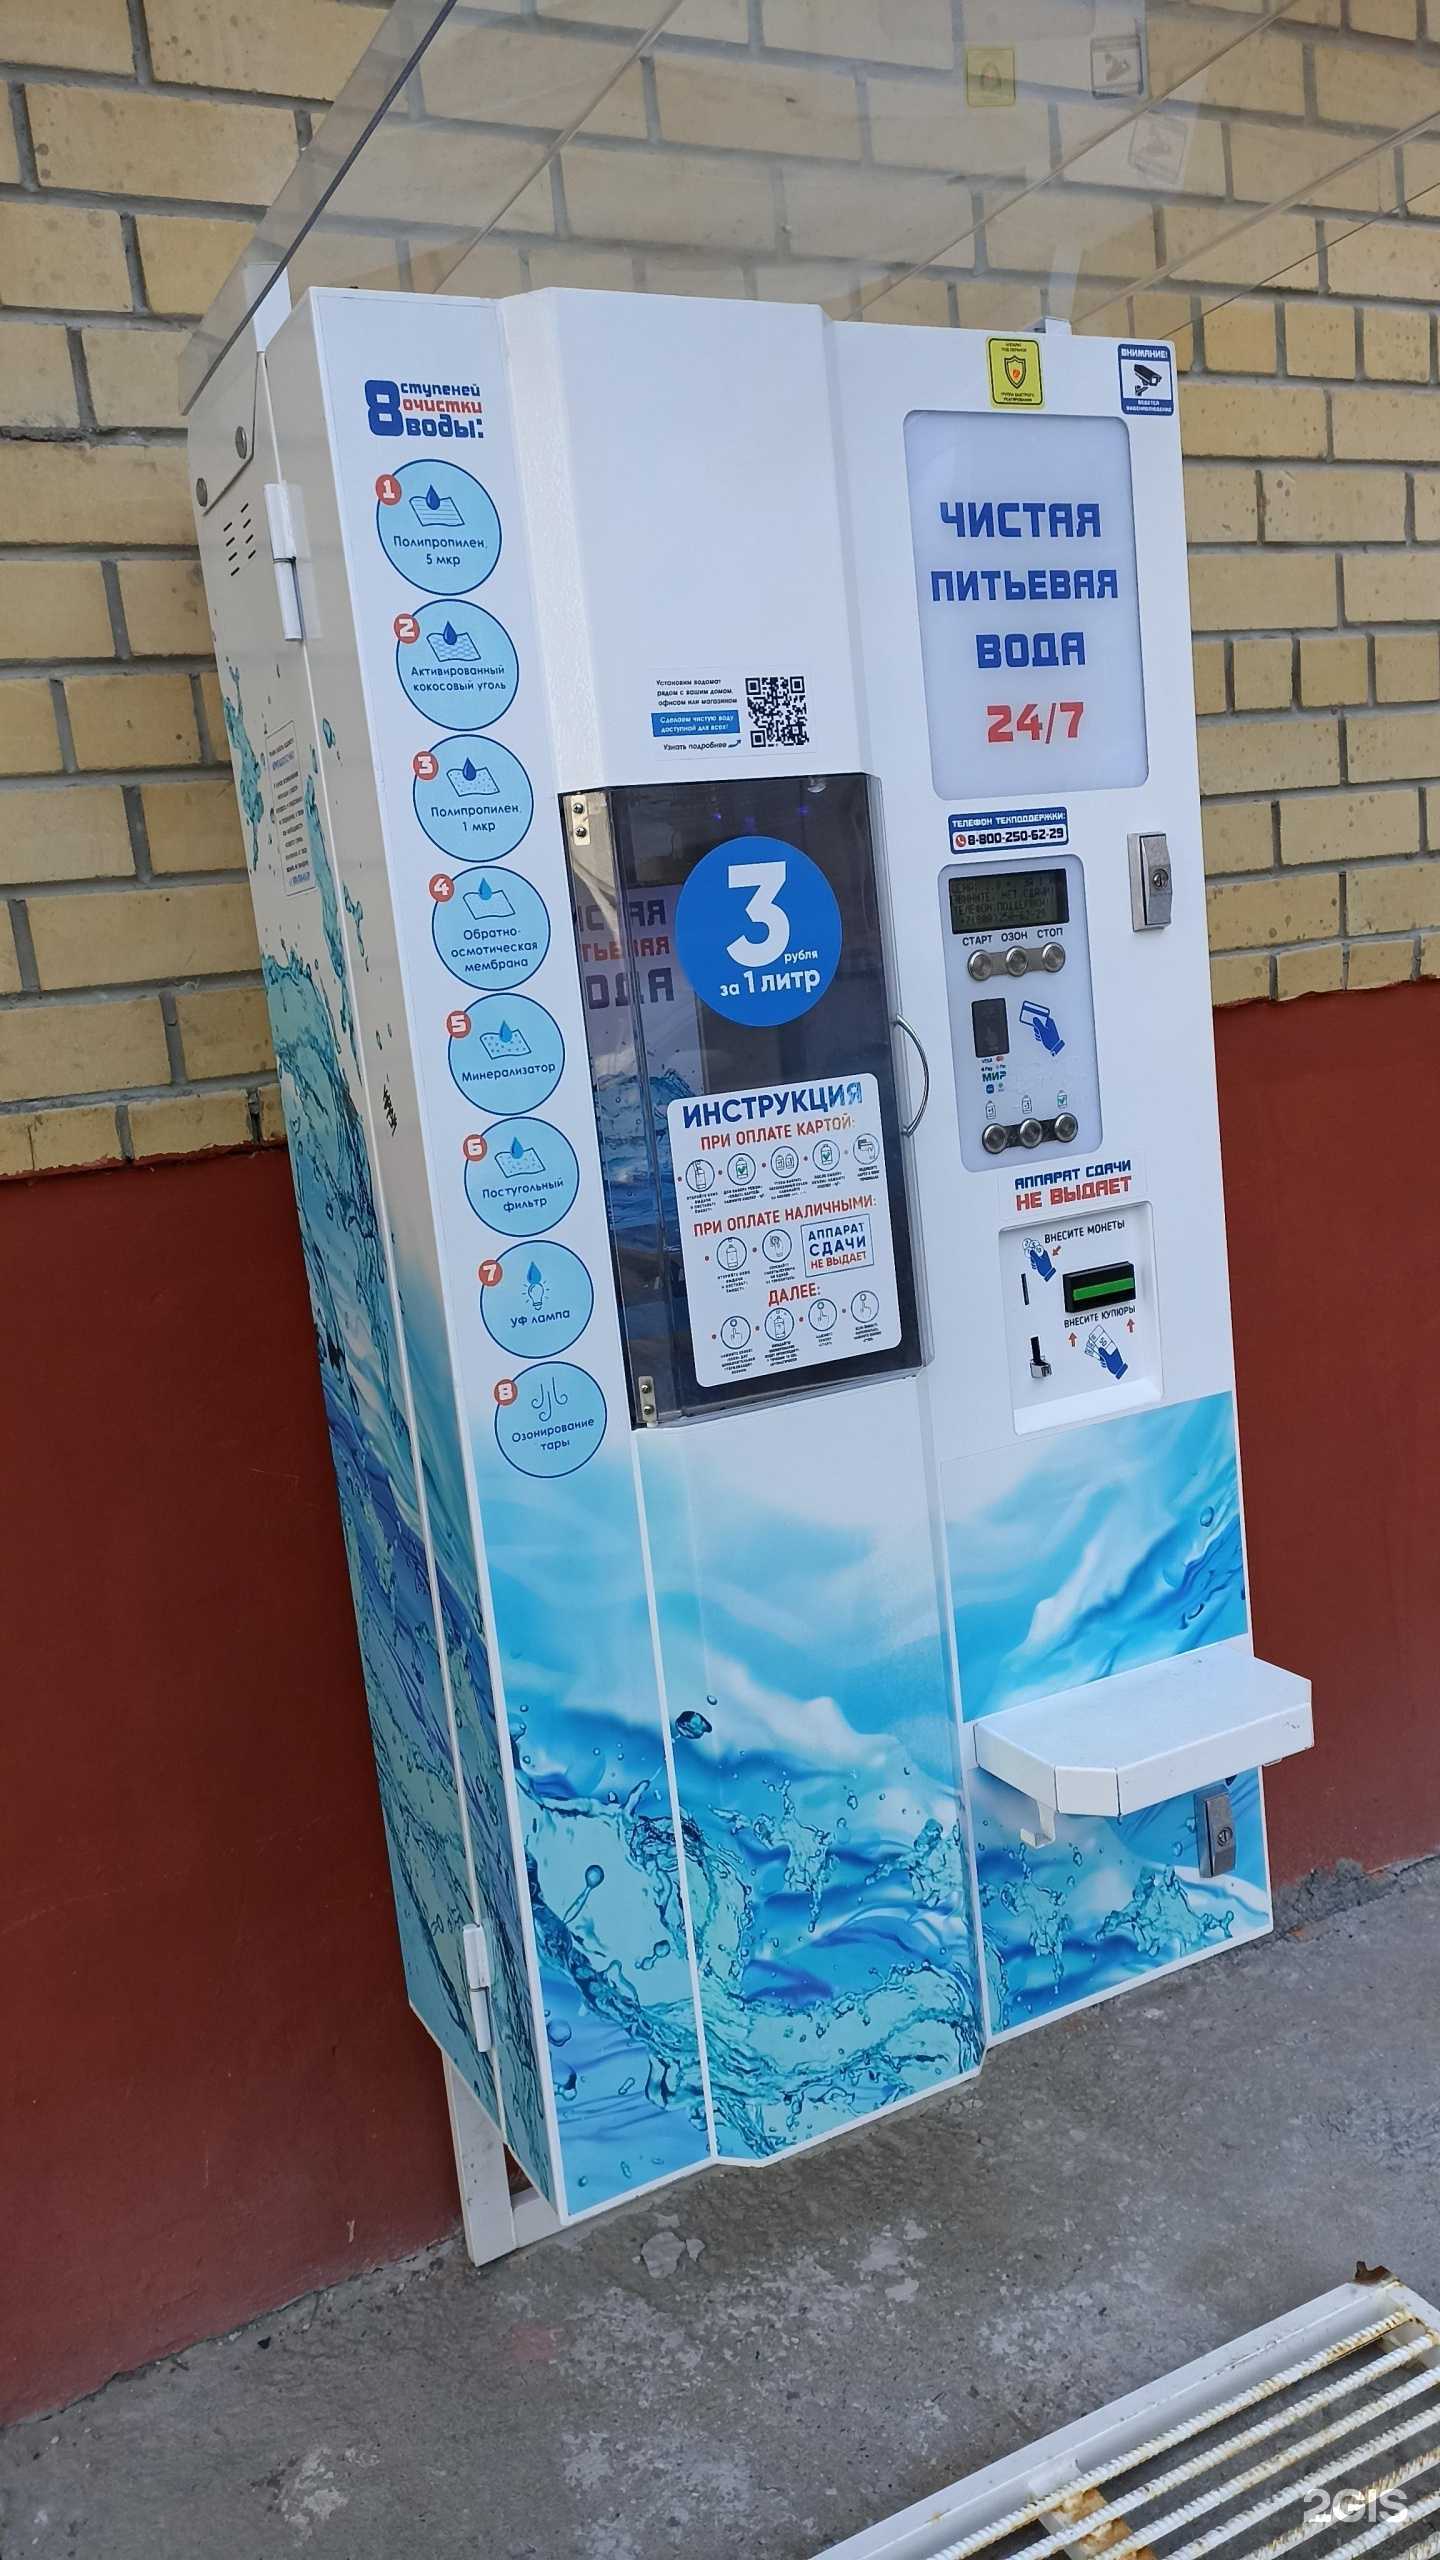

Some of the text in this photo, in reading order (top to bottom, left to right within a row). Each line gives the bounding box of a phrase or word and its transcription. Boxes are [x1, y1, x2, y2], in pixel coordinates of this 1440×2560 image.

[1121, 348, 1168, 359] ВНИМАНИЕ!
[401, 383, 481, 397] ступеней
[365, 380, 404, 436] 8
[403, 399, 482, 413] очистки
[406, 414, 484, 438] воды:
[382, 479, 396, 500] 1
[939, 502, 1102, 538] ЧИСТАЯ
[426, 554, 461, 567] 5 мкр
[931, 569, 1118, 601] ПИТЬЕВАЯ
[399, 619, 416, 638] 2
[975, 632, 1086, 668] ВОДА
[411, 664, 505, 678] Активированный
[413, 680, 506, 692] кокосовый уголь
[658, 699, 686, 707] офисом
[987, 702, 1084, 744] 24/7
[664, 741, 727, 751] Узнать подробнее
[418, 755, 434, 774] 3
[463, 821, 496, 834] 1 мкр
[952, 811, 1066, 828] ТЕЛЕФОН ТЕХПОДДЕРЖКИ:
[968, 828, 1064, 845] 8-800-250-62-29
[434, 877, 450, 896] 4
[727, 861, 790, 968] 3
[962, 927, 1064, 946] СТАРТ ОЗОН СТОП
[451, 941, 538, 958] осмотическая
[784, 949, 818, 964] рубля
[464, 957, 529, 972] мембрана
[720, 968, 821, 997] за 1 литр
[450, 1015, 467, 1034] 5
[462, 1062, 556, 1083] Минерализатор
[982, 1071, 1007, 1082] МИР
[683, 1082, 863, 1129] ИНСТРУКЦИЯ
[701, 1113, 856, 1150] ПРИ ОПЛАТЕ КАРТОЙ:
[1015, 1160, 1132, 1190] АППАРАТ СДАЧИ
[482, 1177, 564, 1200] Постугольный
[1016, 1176, 1132, 1211] НЕ ВЫДАЕТ
[503, 1197, 548, 1213] фильтр
[693, 1195, 877, 1238] ПРИ ОПЛАТЕ НАЛИЧНЫМИ:
[808, 1222, 864, 1242] АППАРАТ
[1045, 1219, 1125, 1244] ВНЕСИТЕ МОНЕТЫ
[809, 1236, 866, 1257] СДАЧИ
[810, 1251, 867, 1270] НЕ ВЫДАЕТ
[483, 1264, 498, 1282] 7
[768, 1283, 821, 1307] ДАЛЕЕ:
[531, 1308, 570, 1325] лампа
[1064, 1305, 1136, 1328] ВНЕСИТЕ КУПЮРЫ
[512, 1417, 595, 1444] Озонирование
[540, 1438, 570, 1452] тары
